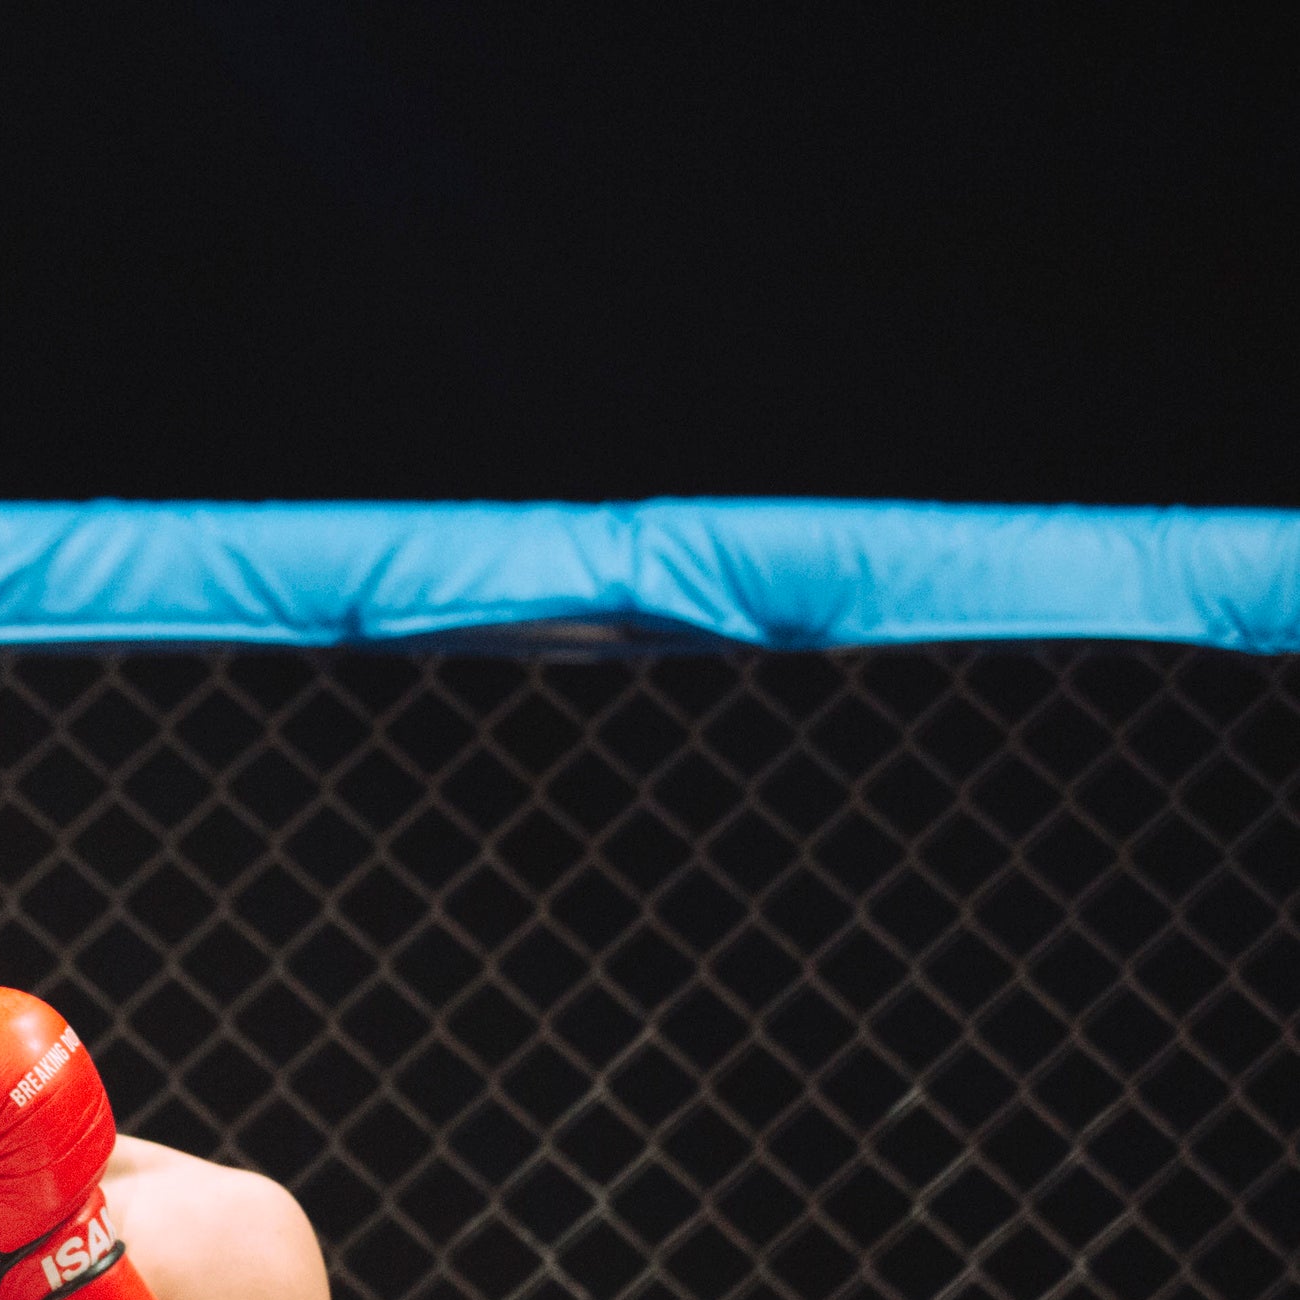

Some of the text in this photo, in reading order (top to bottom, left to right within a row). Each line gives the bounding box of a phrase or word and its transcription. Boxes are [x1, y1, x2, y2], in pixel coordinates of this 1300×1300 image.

[9, 1025, 83, 1108] BREAKING DO
[40, 1203, 118, 1291] ISA
